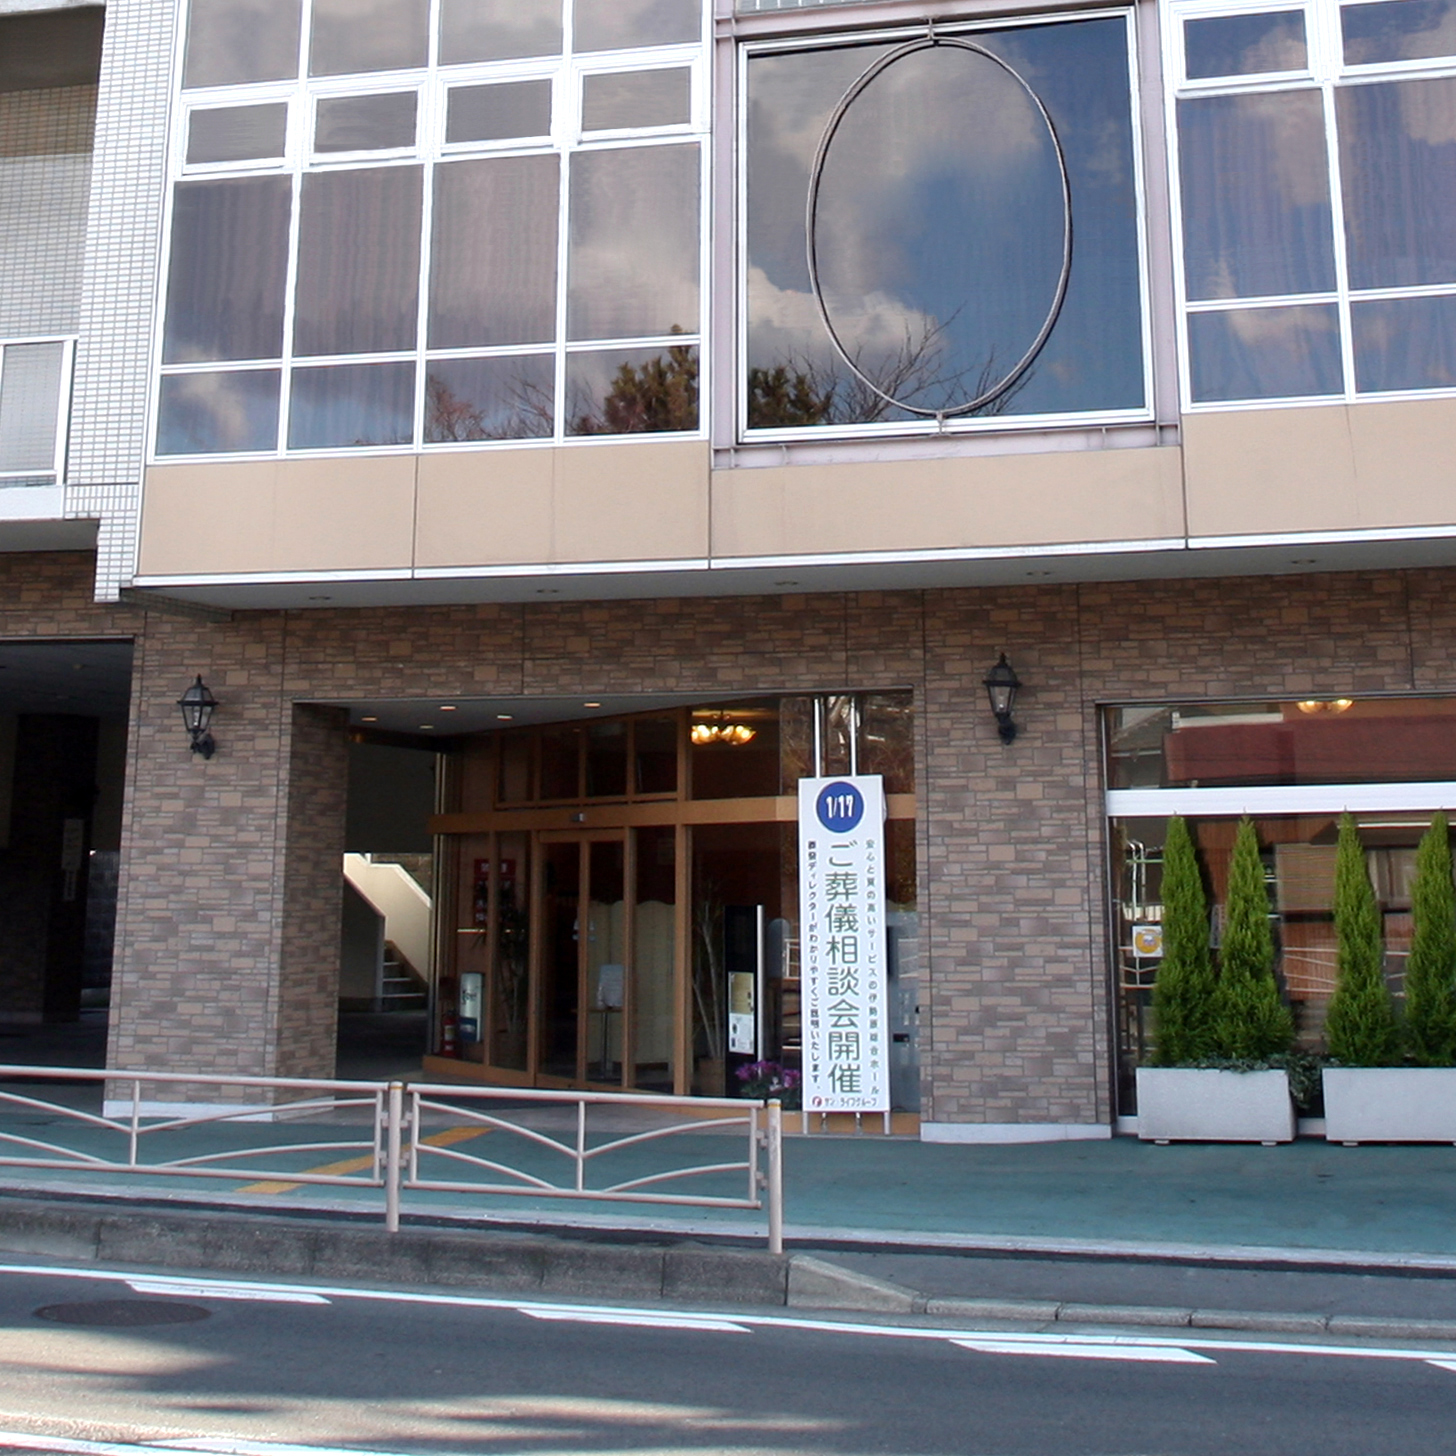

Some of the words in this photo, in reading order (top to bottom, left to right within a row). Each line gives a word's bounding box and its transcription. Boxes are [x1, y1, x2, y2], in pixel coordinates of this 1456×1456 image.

[826, 794, 854, 819] 1/17
[824, 839, 862, 1094] ご葬儀相談会開催
